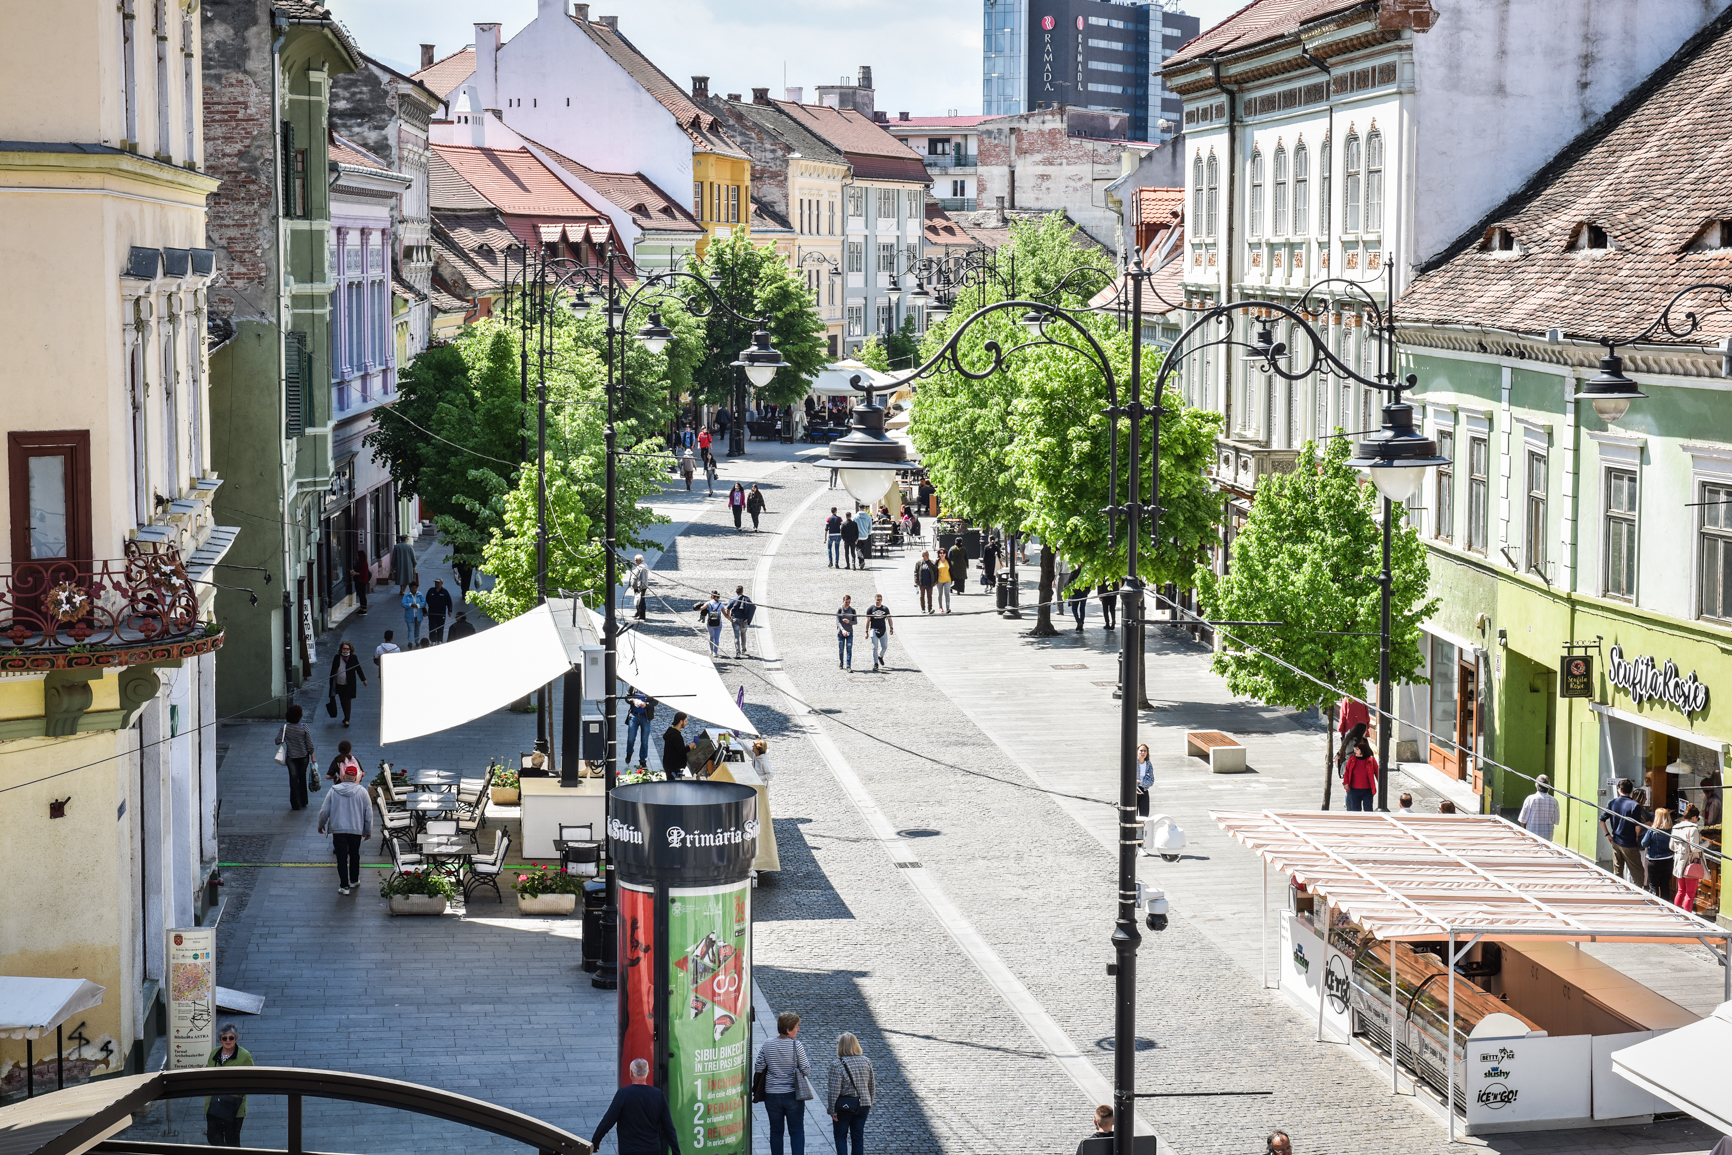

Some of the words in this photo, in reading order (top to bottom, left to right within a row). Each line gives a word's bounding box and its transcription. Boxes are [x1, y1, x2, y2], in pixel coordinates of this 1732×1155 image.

[719, 1040, 745, 1059] BIKECIT
[704, 1060, 719, 1072] TREI
[1483, 1069, 1511, 1080] slushy
[693, 1078, 703, 1101] 1
[706, 1071, 746, 1092] ÎNCHIRIAZ
[693, 1102, 705, 1125] 2
[693, 1126, 705, 1149] 3
